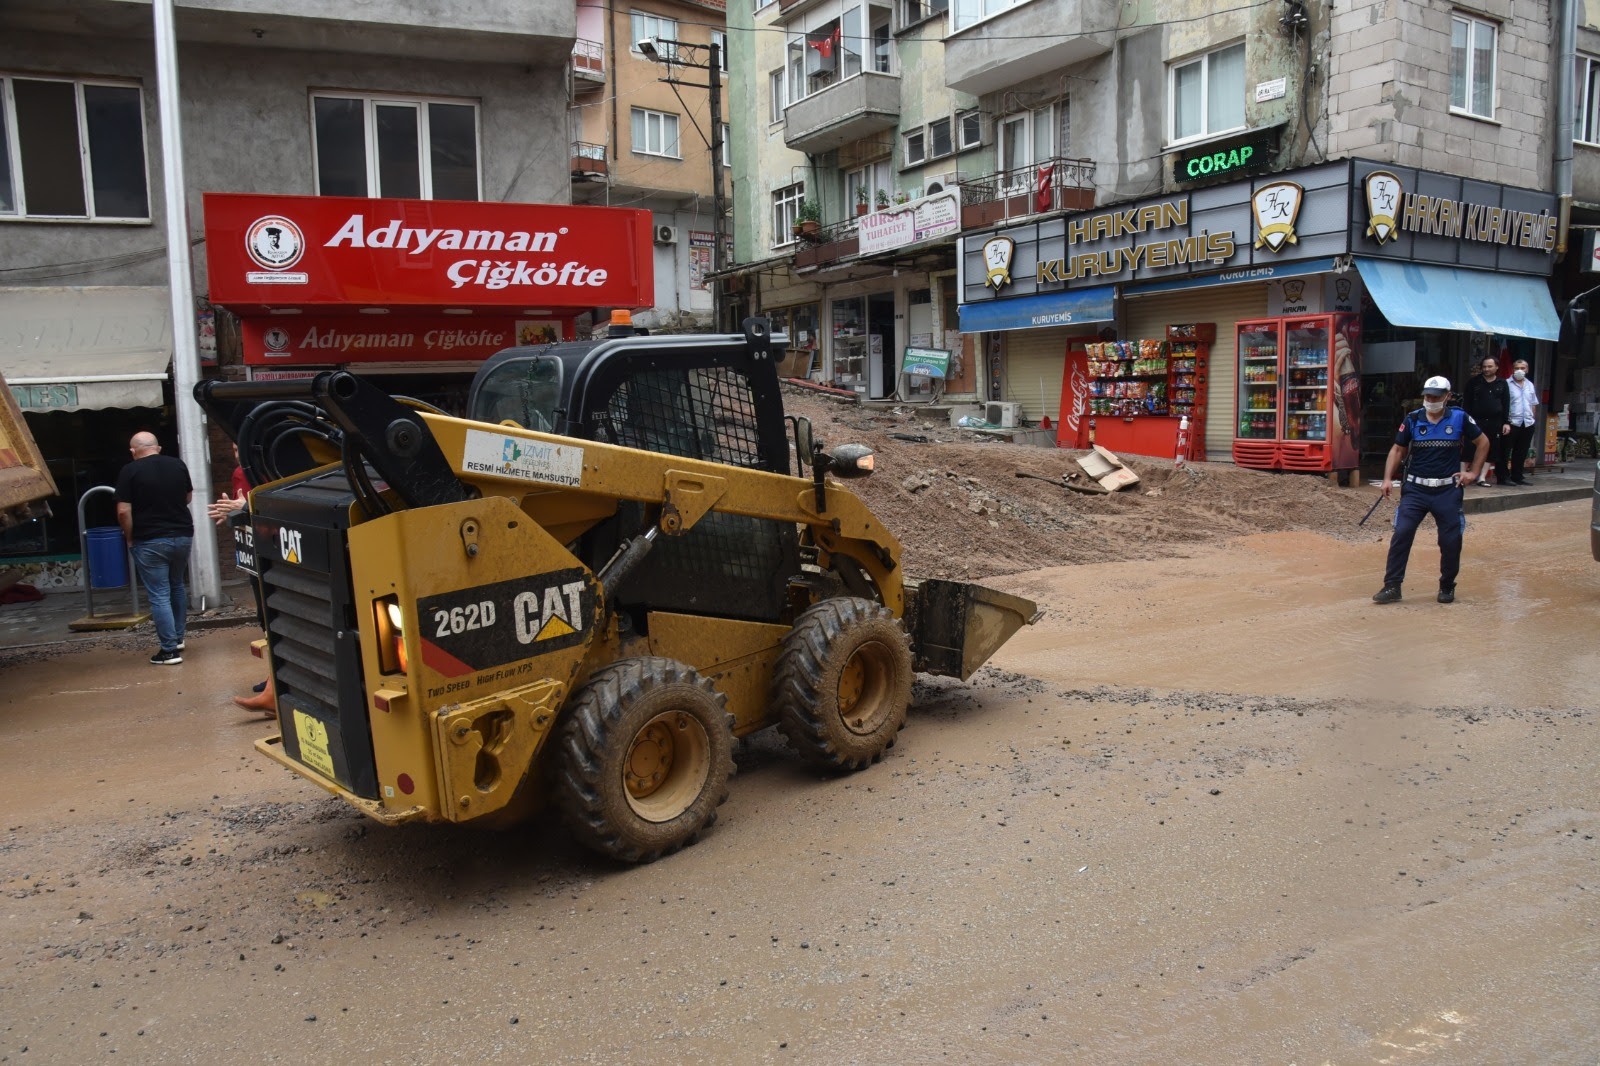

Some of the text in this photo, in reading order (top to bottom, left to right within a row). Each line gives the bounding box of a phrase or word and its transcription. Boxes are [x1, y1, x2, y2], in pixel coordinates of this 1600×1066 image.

[1187, 146, 1253, 177] CORAP
[323, 214, 558, 255] Adıyaman
[866, 222, 907, 241] TUHAFİYE
[1069, 199, 1188, 245] HAKAN
[1402, 192, 1557, 254] HAKAN KURUYEMİŞ
[1036, 228, 1235, 284] KURUYEMİŞ
[447, 260, 608, 290] Çiğköfte
[1031, 311, 1072, 325] KURUYEMİŞ
[1282, 305, 1308, 314] HAKAN
[1334, 305, 1353, 313] HAKAN
[299, 326, 503, 352] Adıyaman Çiğköfte
[524, 441, 553, 461] İZMİT
[467, 461, 580, 486] RESMİ HİZMETE MAHSUSTUR
[234, 530, 244, 544] 41
[280, 526, 302, 563] CAT
[239, 550, 254, 567] 0041
[434, 600, 496, 638] 262D
[513, 580, 585, 645] CAT
[517, 662, 533, 675] XPS
